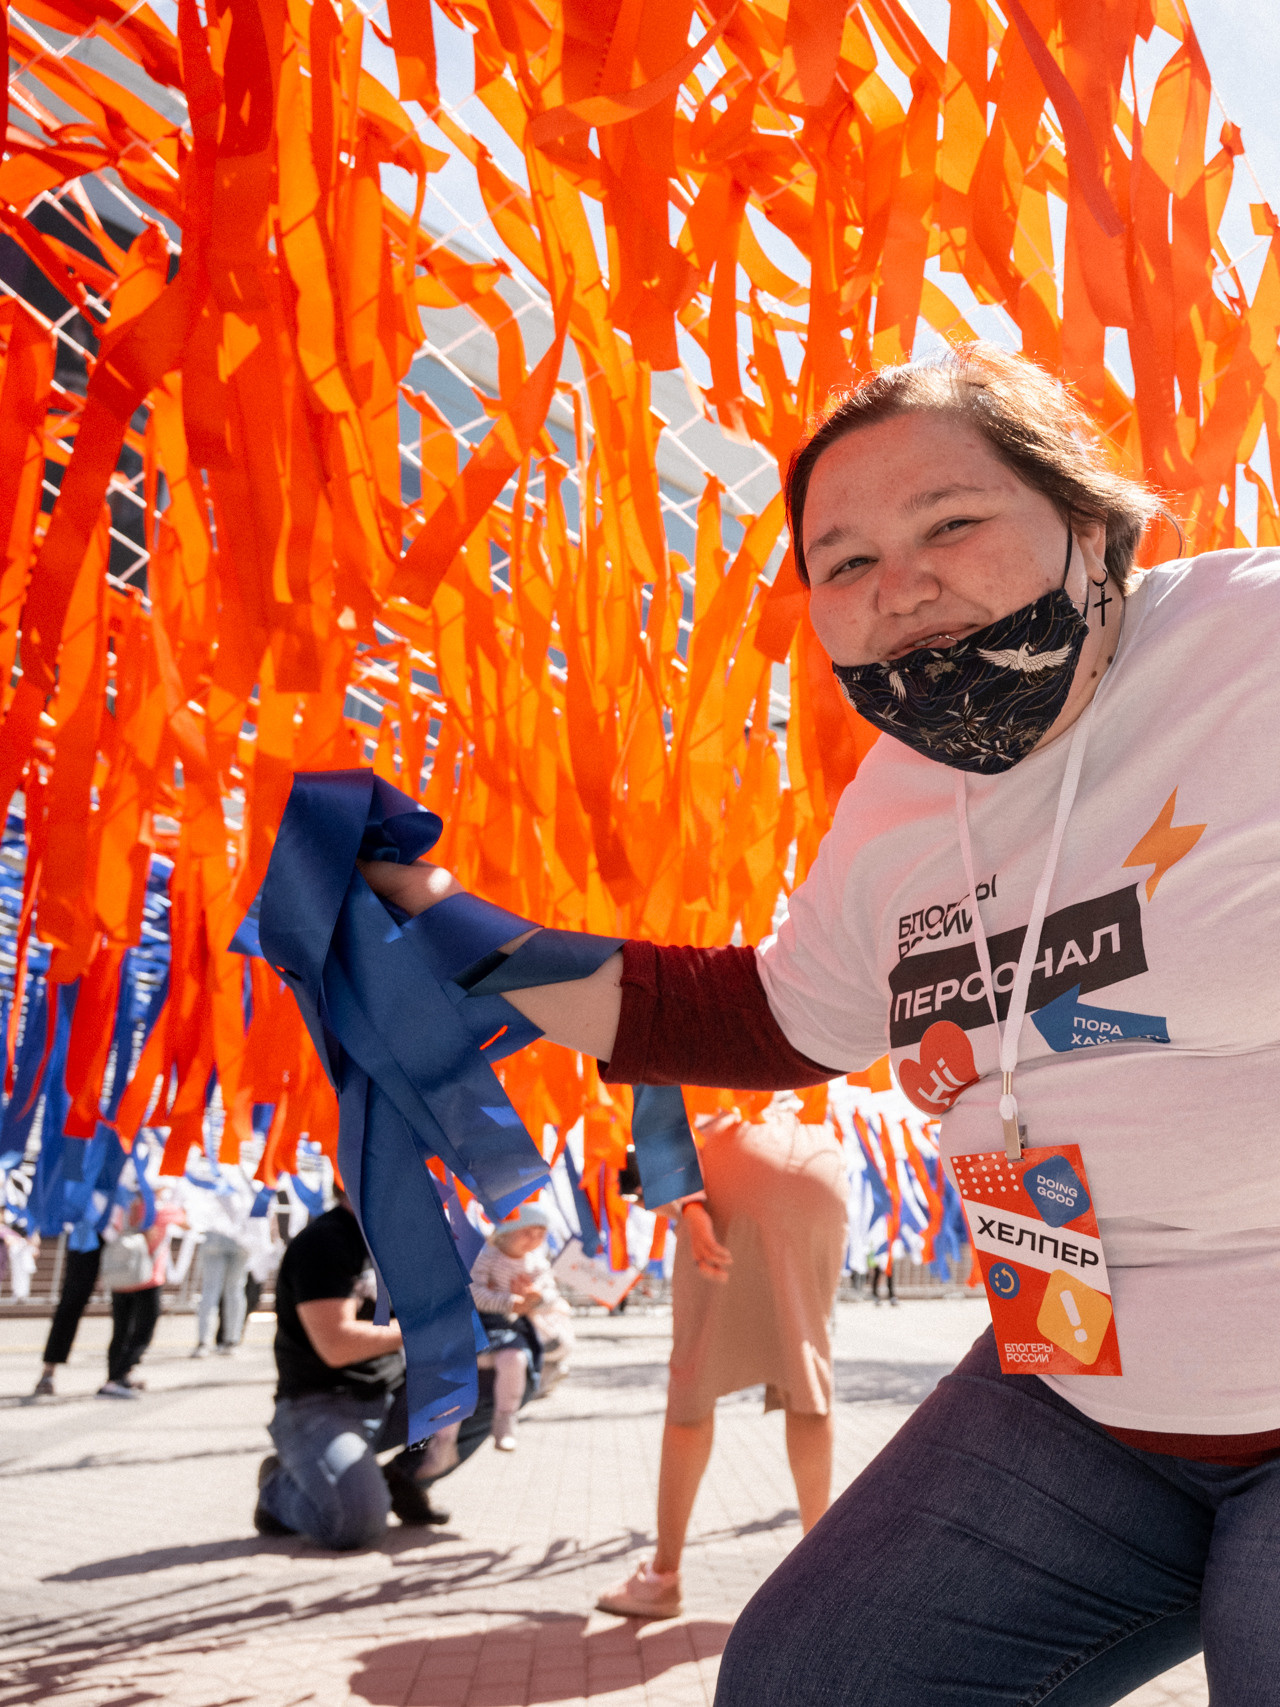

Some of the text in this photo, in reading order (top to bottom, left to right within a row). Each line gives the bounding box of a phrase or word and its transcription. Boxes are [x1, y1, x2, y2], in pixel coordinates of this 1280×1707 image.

[894, 922, 1121, 1023] ПЕРСОНАЛ
[1073, 1016, 1124, 1036] ПОРА
[1036, 1174, 1078, 1198] DOING
[1036, 1186, 1075, 1208] GOOD
[977, 1215, 1099, 1268] ХЕЛПЕР
[1004, 1343, 1054, 1353] БЛОГЕРЫ
[1006, 1352, 1050, 1363] РОССИИ
